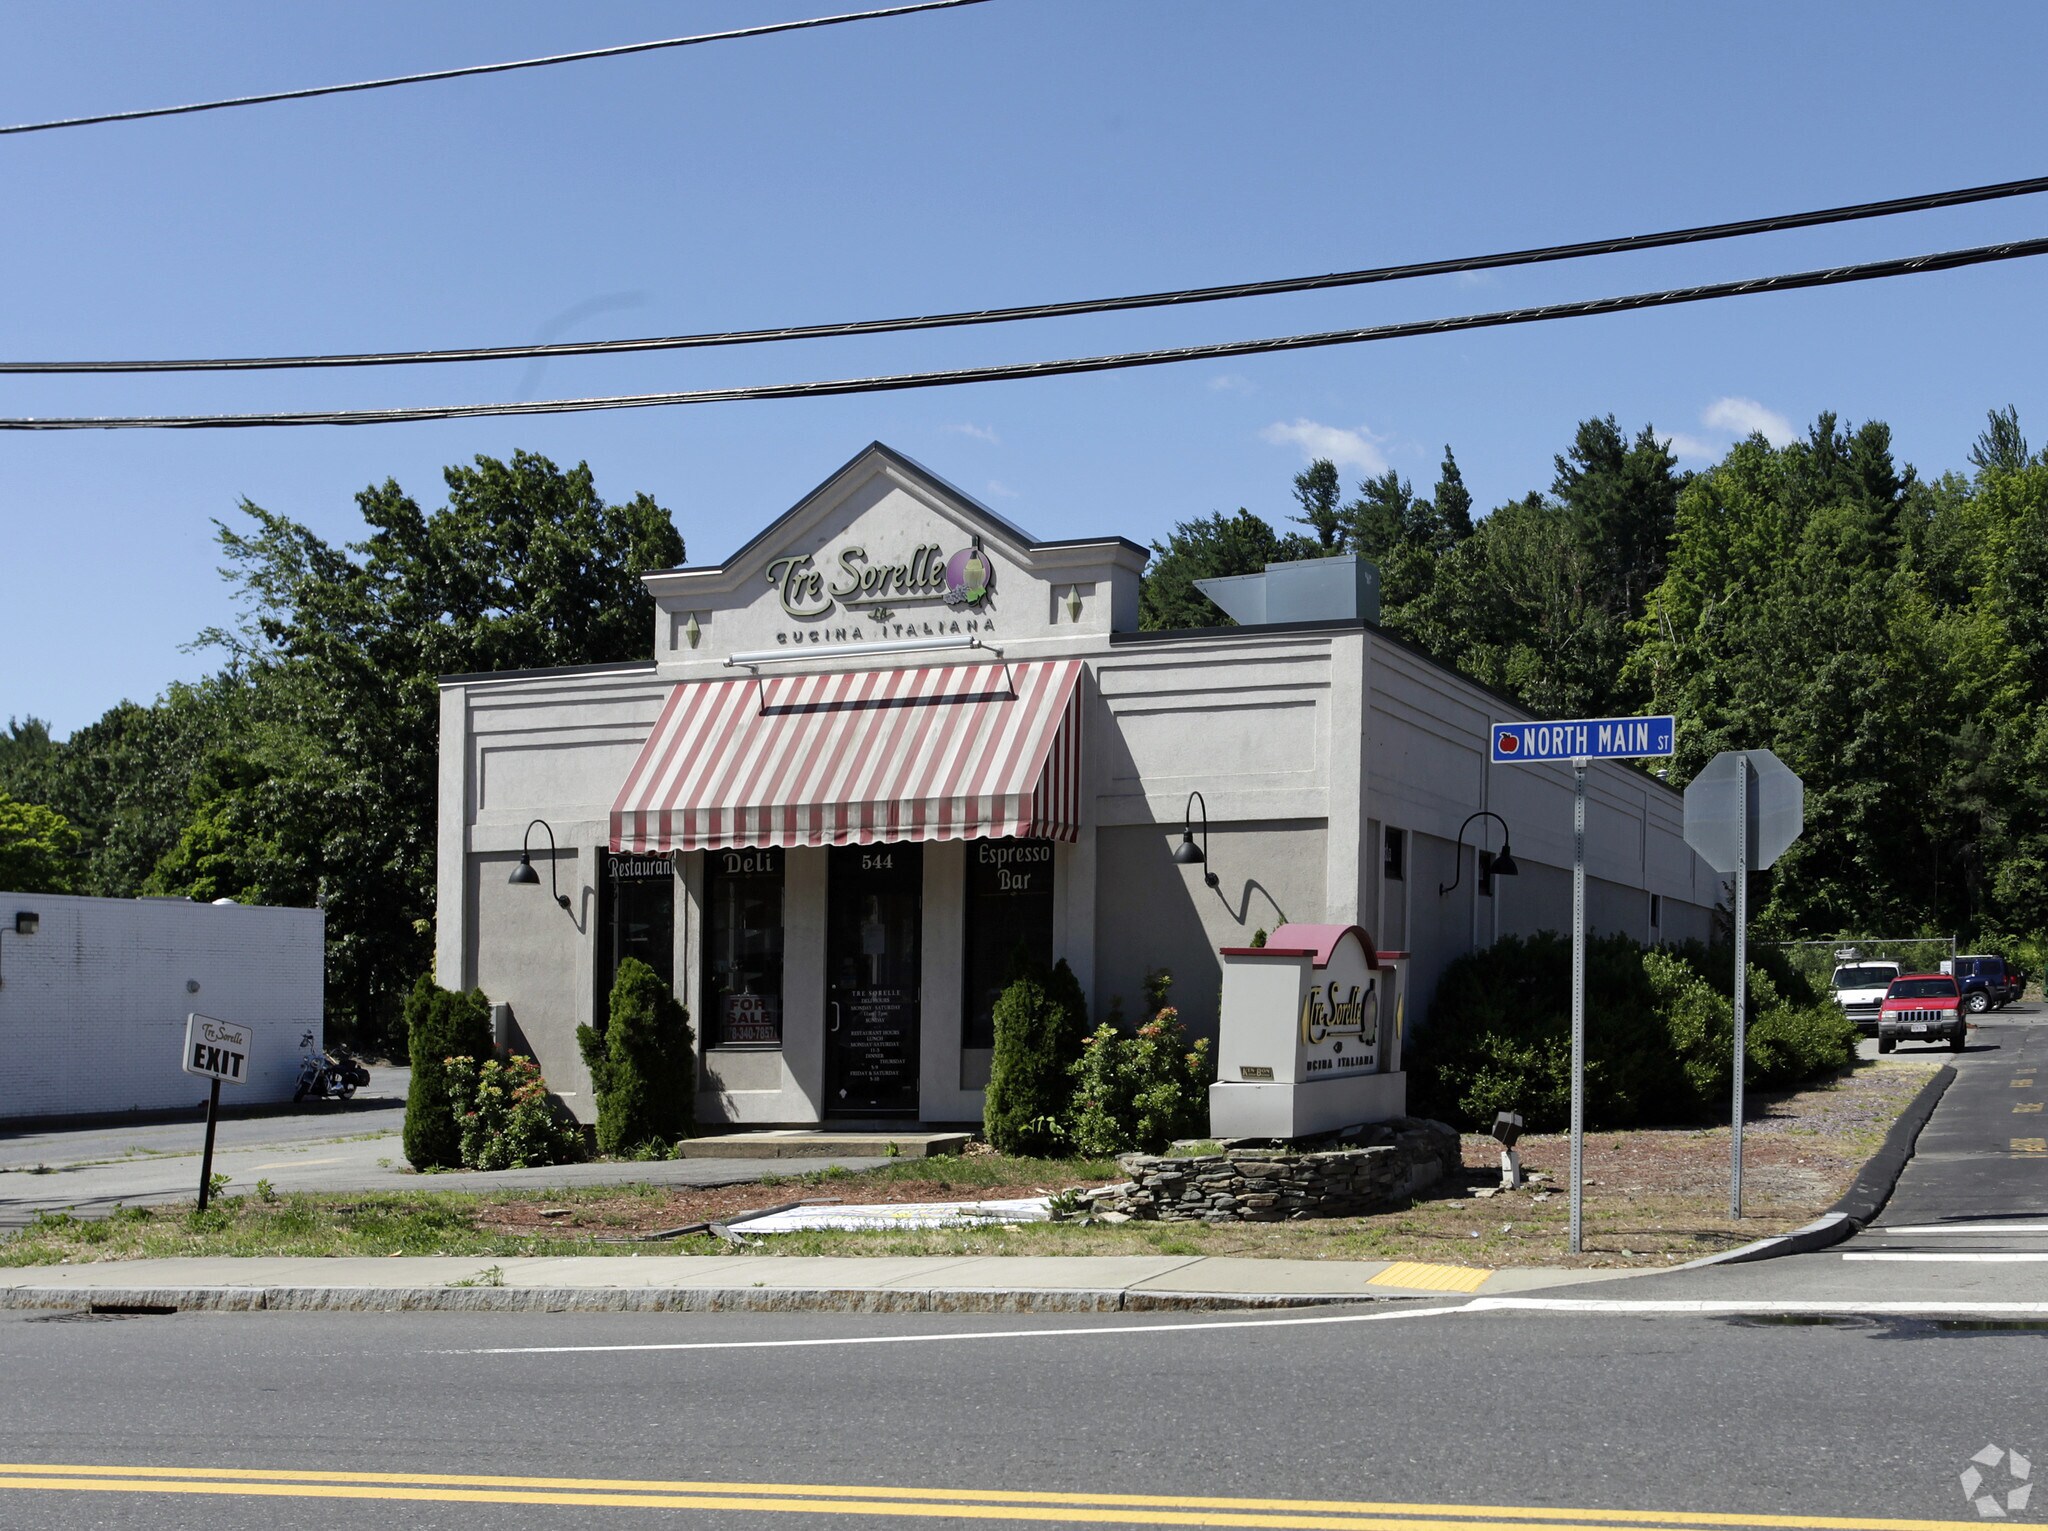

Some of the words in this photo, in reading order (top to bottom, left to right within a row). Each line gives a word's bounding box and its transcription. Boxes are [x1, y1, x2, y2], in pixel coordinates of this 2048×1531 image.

[766, 554, 832, 617] Tre
[828, 543, 945, 597] Sorelle
[776, 627, 863, 644] CUCINA
[882, 619, 996, 638] ITALIANA
[1523, 725, 1587, 756] NORTH
[1598, 723, 1649, 753] MAIN
[1657, 735, 1670, 750] ST
[722, 852, 774, 874] Deli
[862, 854, 893, 870] 544
[979, 843, 1050, 868] Espresso
[608, 857, 676, 878] Restaurant
[997, 868, 1031, 891] Bar
[730, 998, 766, 1011] FOR
[1323, 981, 1362, 1027] Sorelle
[727, 1011, 771, 1024] SALE
[202, 1023, 218, 1043] Tre
[216, 1026, 243, 1045] Sorelle
[193, 1042, 245, 1078] EXIT
[1306, 1059, 1333, 1071] UCINA
[1337, 1055, 1374, 1068] ITALIANA
